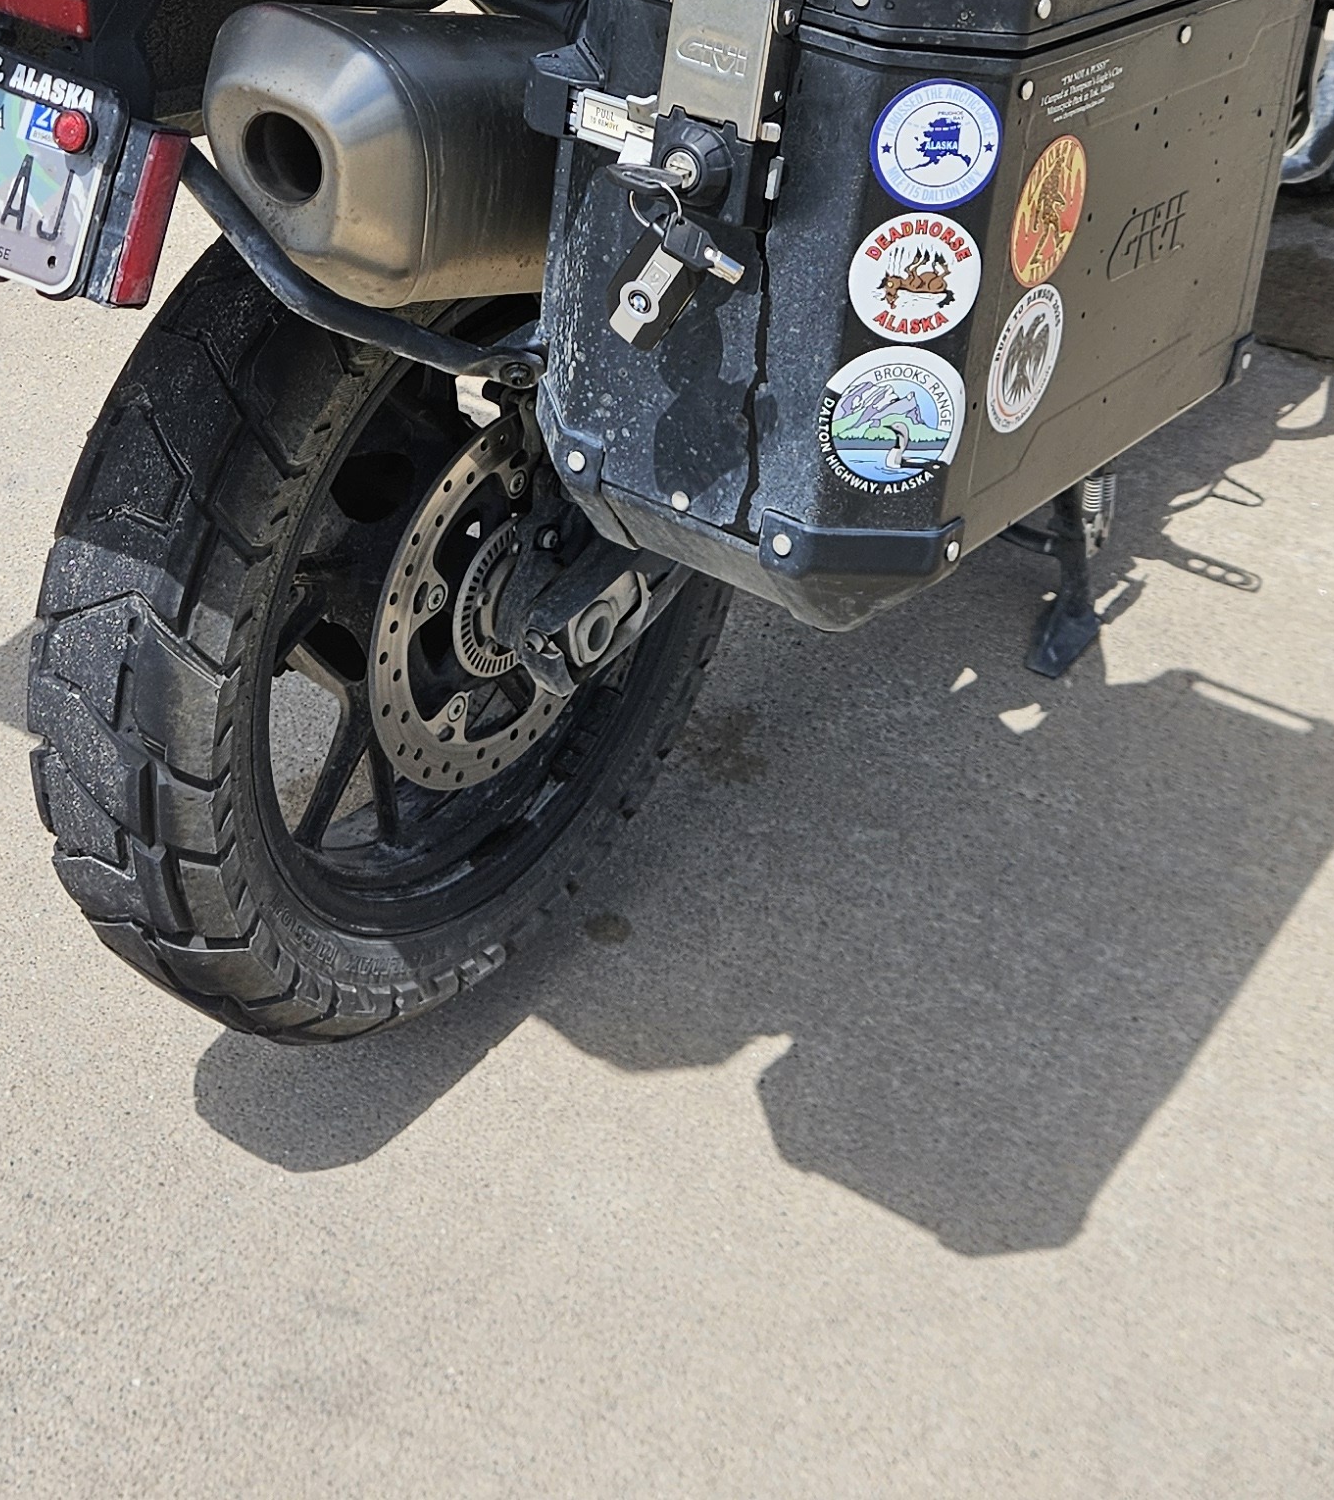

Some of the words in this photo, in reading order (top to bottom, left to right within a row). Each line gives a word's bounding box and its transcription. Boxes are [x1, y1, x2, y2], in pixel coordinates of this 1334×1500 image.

[8, 63, 95, 113] ALASKA
[885, 94, 923, 131] CROSSED
[925, 87, 944, 101] THE
[945, 87, 978, 110] ARCTIC
[974, 104, 996, 138] CIRCLE
[925, 141, 958, 150] ALASKA
[0, 154, 76, 242] AJ
[887, 165, 904, 188] MILE
[903, 182, 920, 198] 115
[921, 187, 961, 202] DALTON
[959, 168, 983, 192] HWY
[865, 219, 973, 262] DEADHORSE
[873, 310, 949, 335] ALASKA
[1012, 303, 1025, 321] TO
[1026, 287, 1056, 307] DAWSON
[873, 366, 931, 385] BROOKS
[928, 382, 953, 427] RANGE
[818, 396, 836, 453] DALTON
[825, 454, 881, 496] HIGHWAY,
[883, 470, 935, 495] ALASKA
